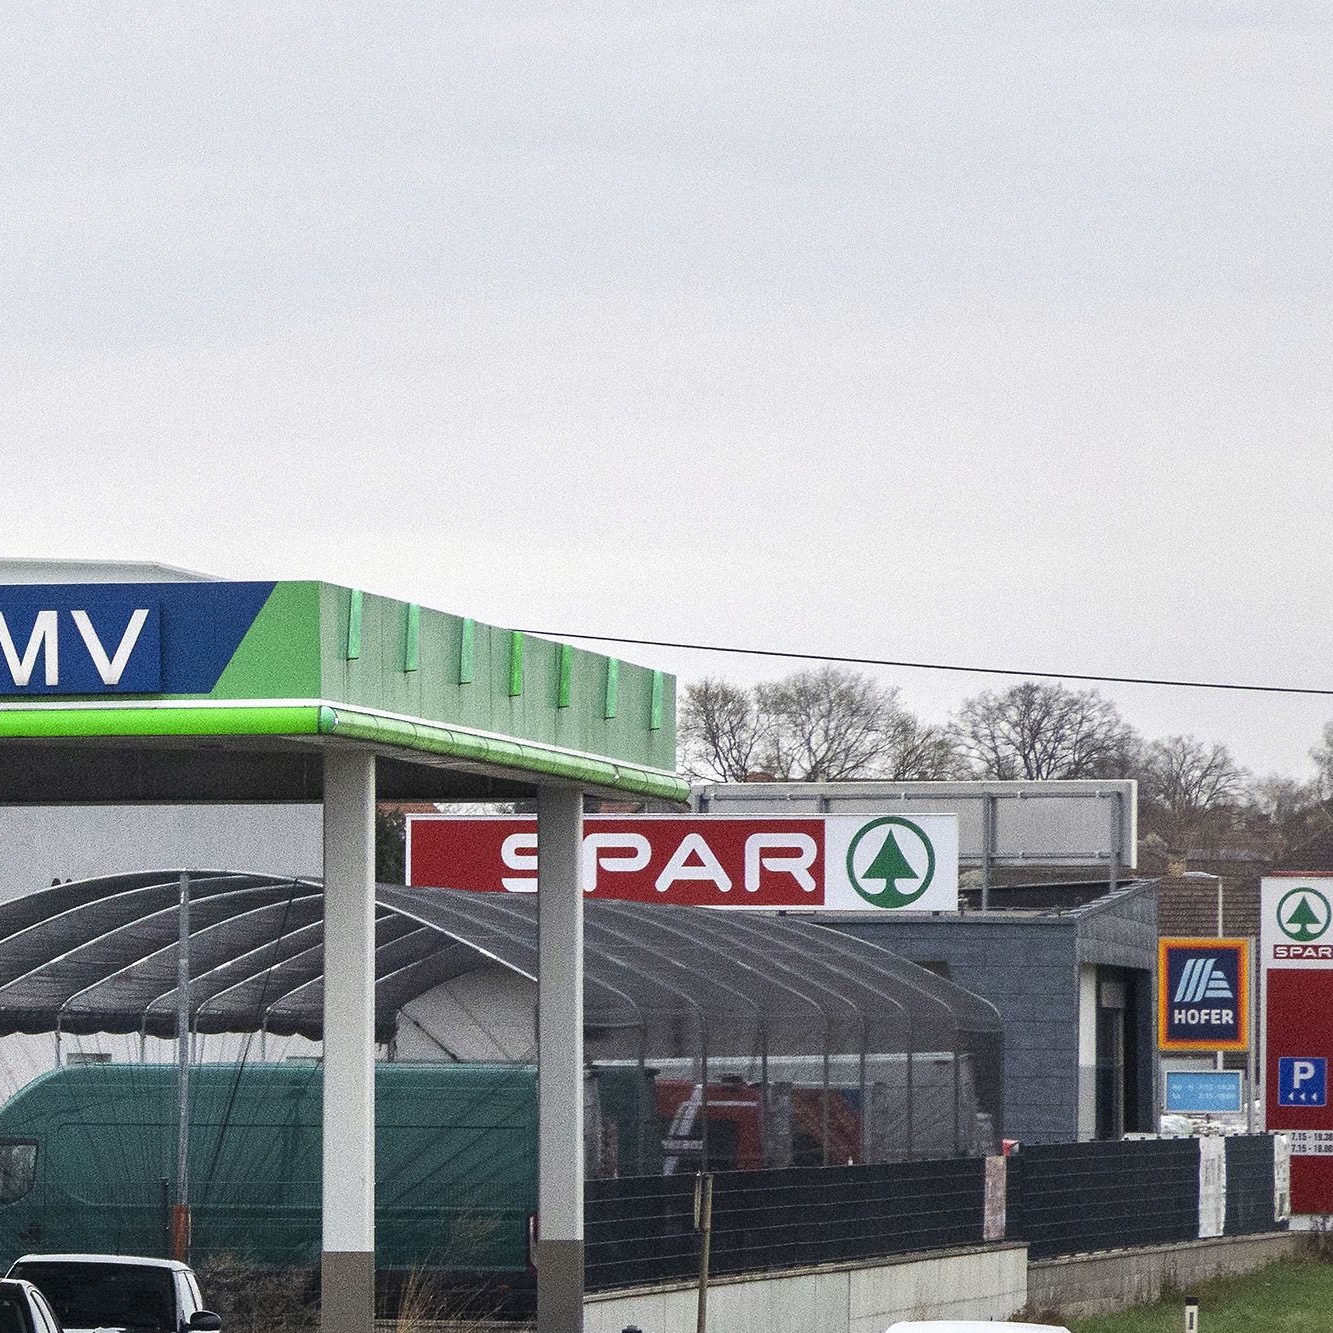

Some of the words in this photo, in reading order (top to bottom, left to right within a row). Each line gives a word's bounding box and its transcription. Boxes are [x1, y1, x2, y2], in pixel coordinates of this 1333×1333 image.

[1275, 945, 1333, 959] SPAR
[1173, 1008, 1234, 1025] HOFER
[1293, 1061, 1315, 1089] P
